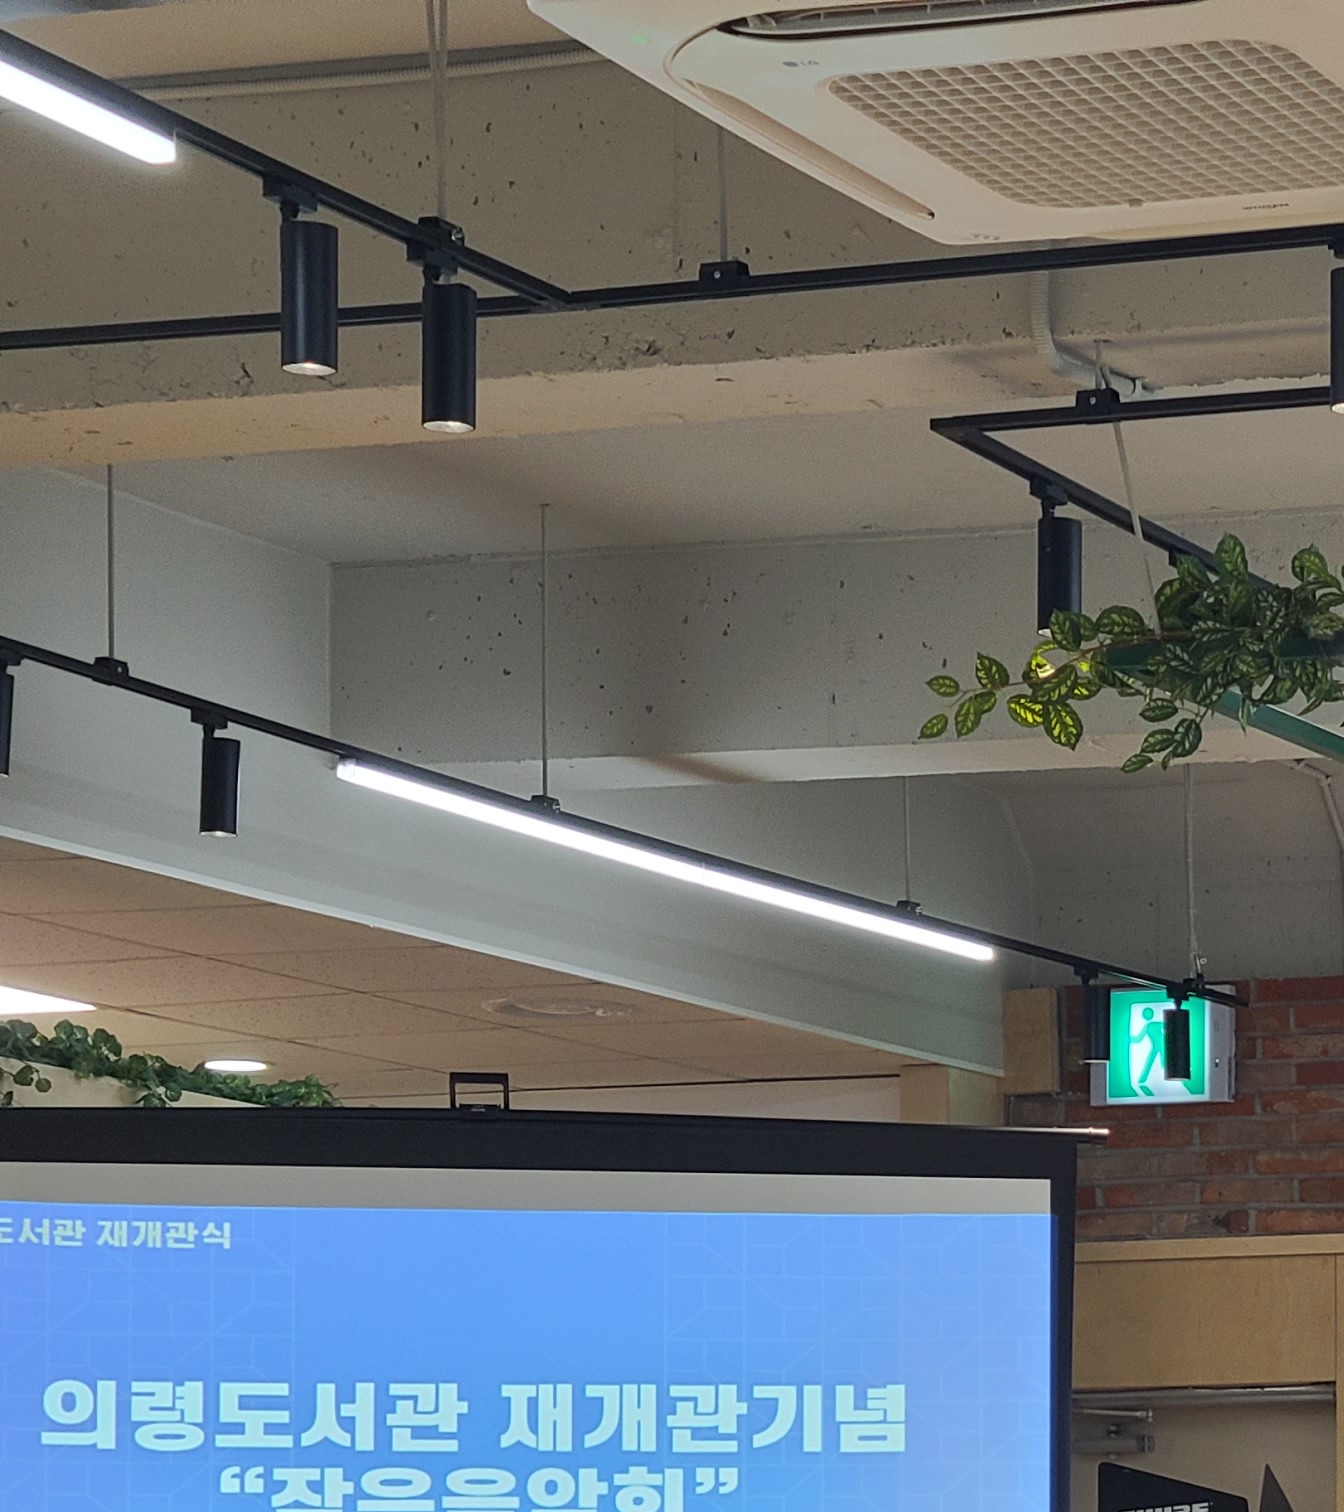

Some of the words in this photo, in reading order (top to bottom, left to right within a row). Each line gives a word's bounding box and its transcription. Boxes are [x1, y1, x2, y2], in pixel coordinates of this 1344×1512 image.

[96, 1219, 232, 1250] 재개관식
[41, 1378, 469, 1453] 의령도서관
[499, 1383, 906, 1454] 재개관기념
